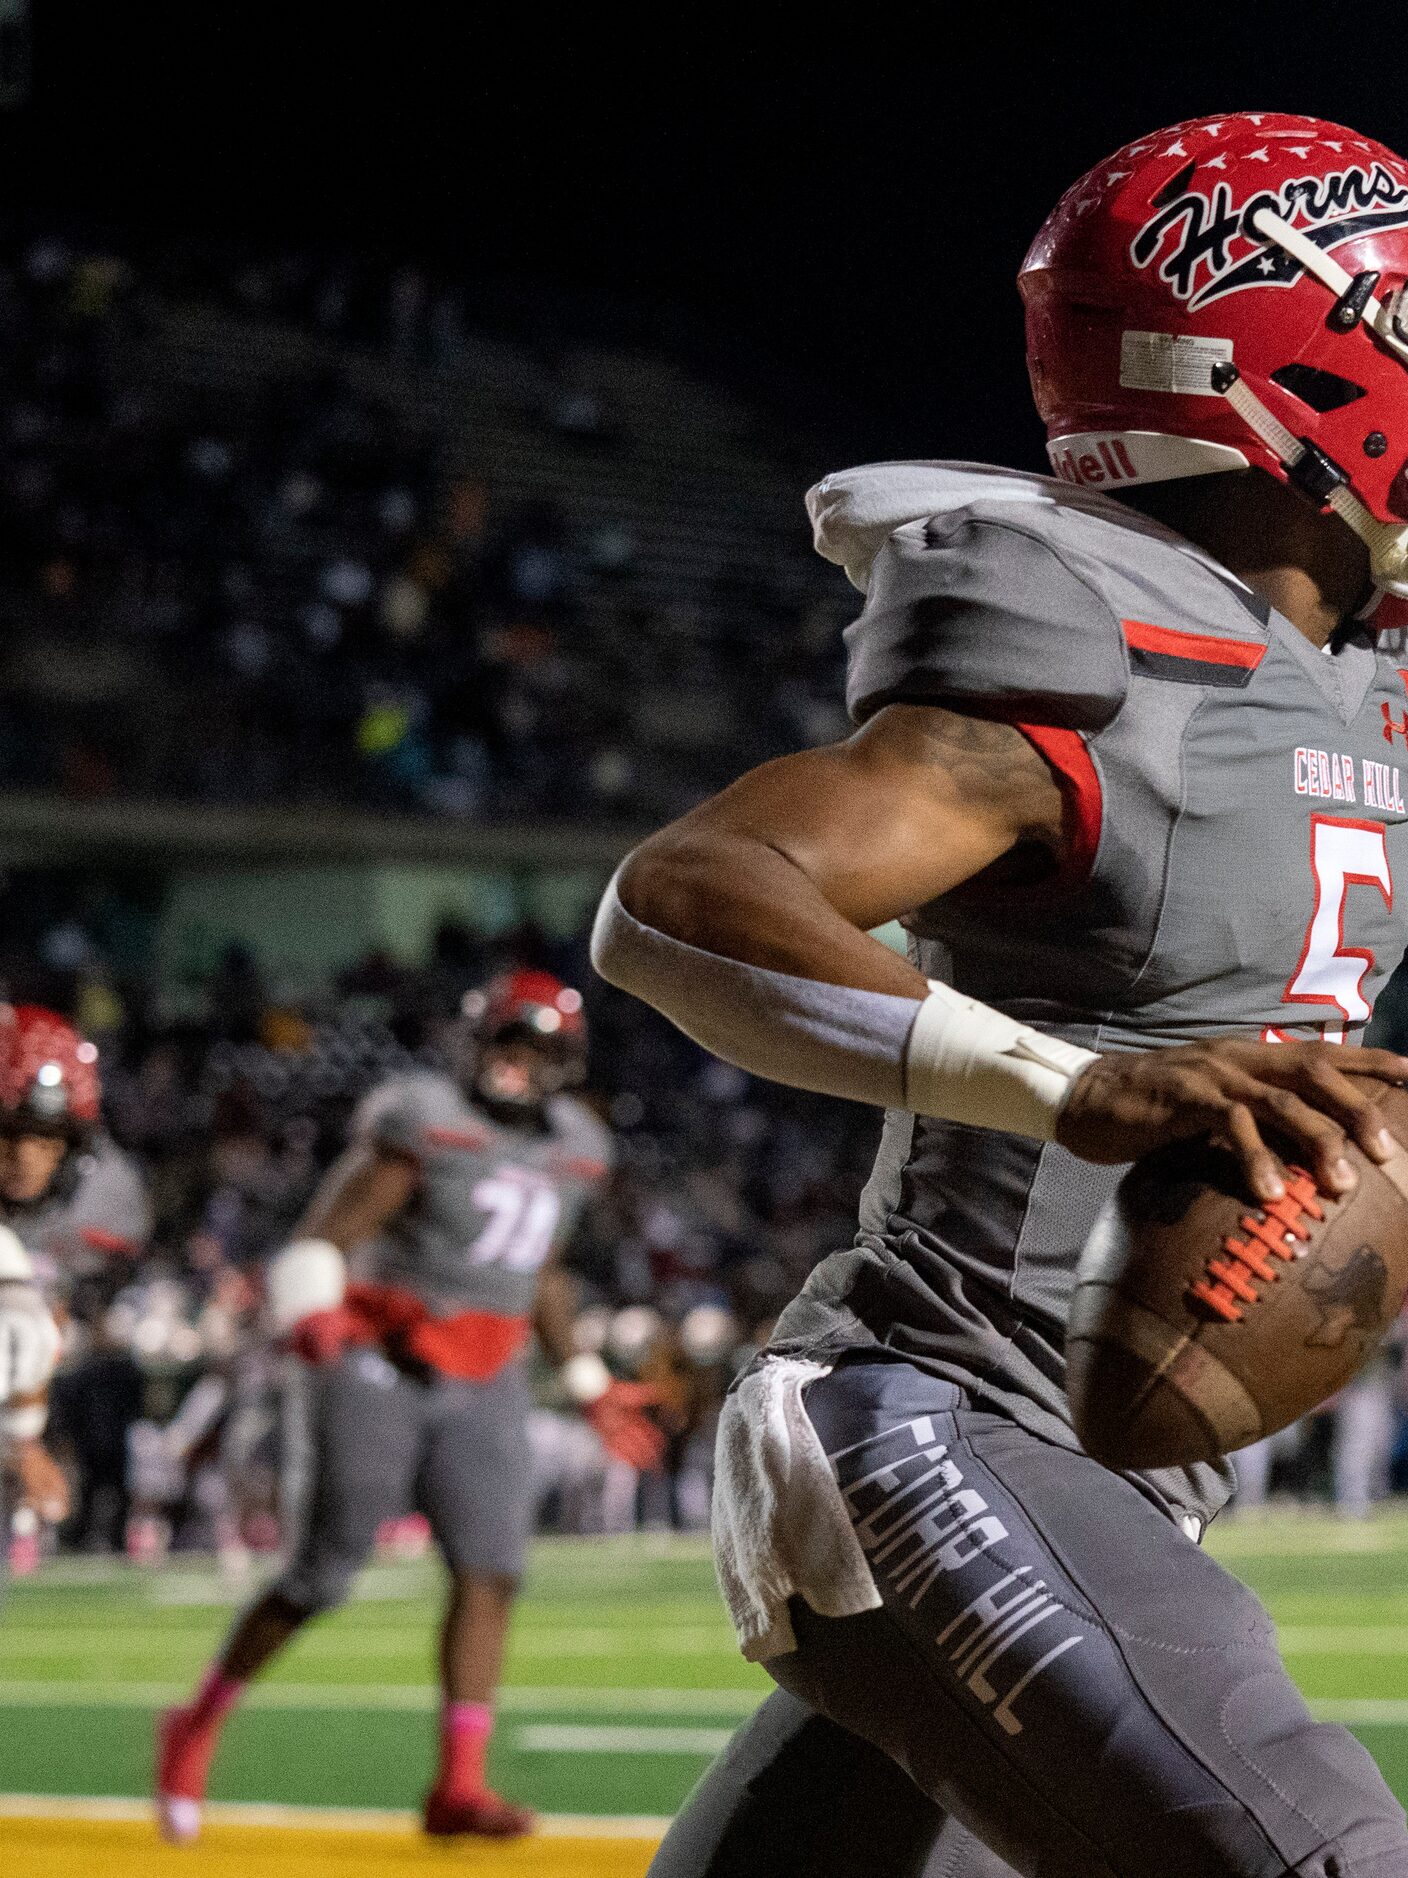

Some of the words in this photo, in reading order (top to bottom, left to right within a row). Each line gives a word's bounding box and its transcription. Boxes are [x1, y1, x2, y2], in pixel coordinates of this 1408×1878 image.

[1052, 439, 1137, 486] dell
[1294, 747, 1356, 803] CEDAR
[1362, 759, 1405, 814] HILL
[1261, 812, 1394, 1045] 5
[827, 1416, 1009, 1609] CEDAR
[935, 1565, 1084, 1735] HILL
